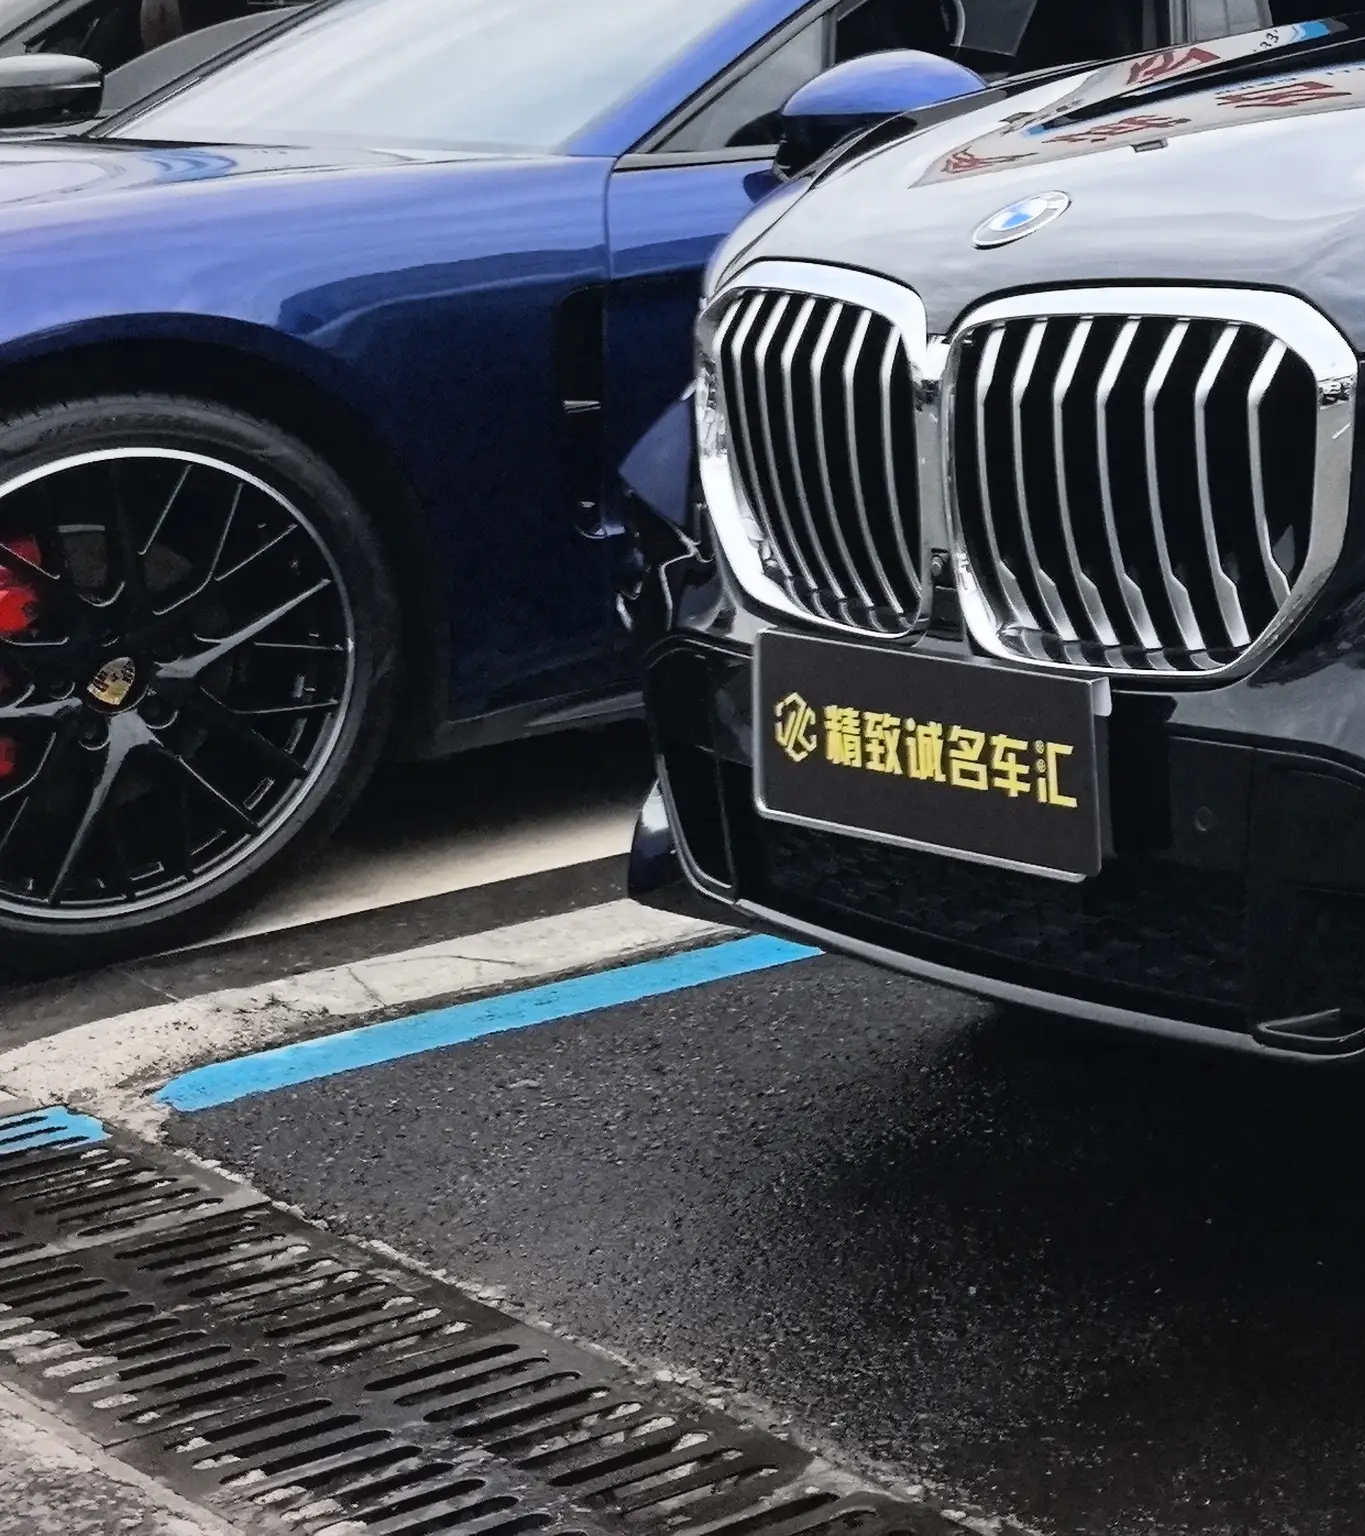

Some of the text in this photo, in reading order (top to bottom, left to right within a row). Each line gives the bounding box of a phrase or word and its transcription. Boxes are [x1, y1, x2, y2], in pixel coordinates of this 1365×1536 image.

[823, 704, 1078, 808] 精致诚名车汇
